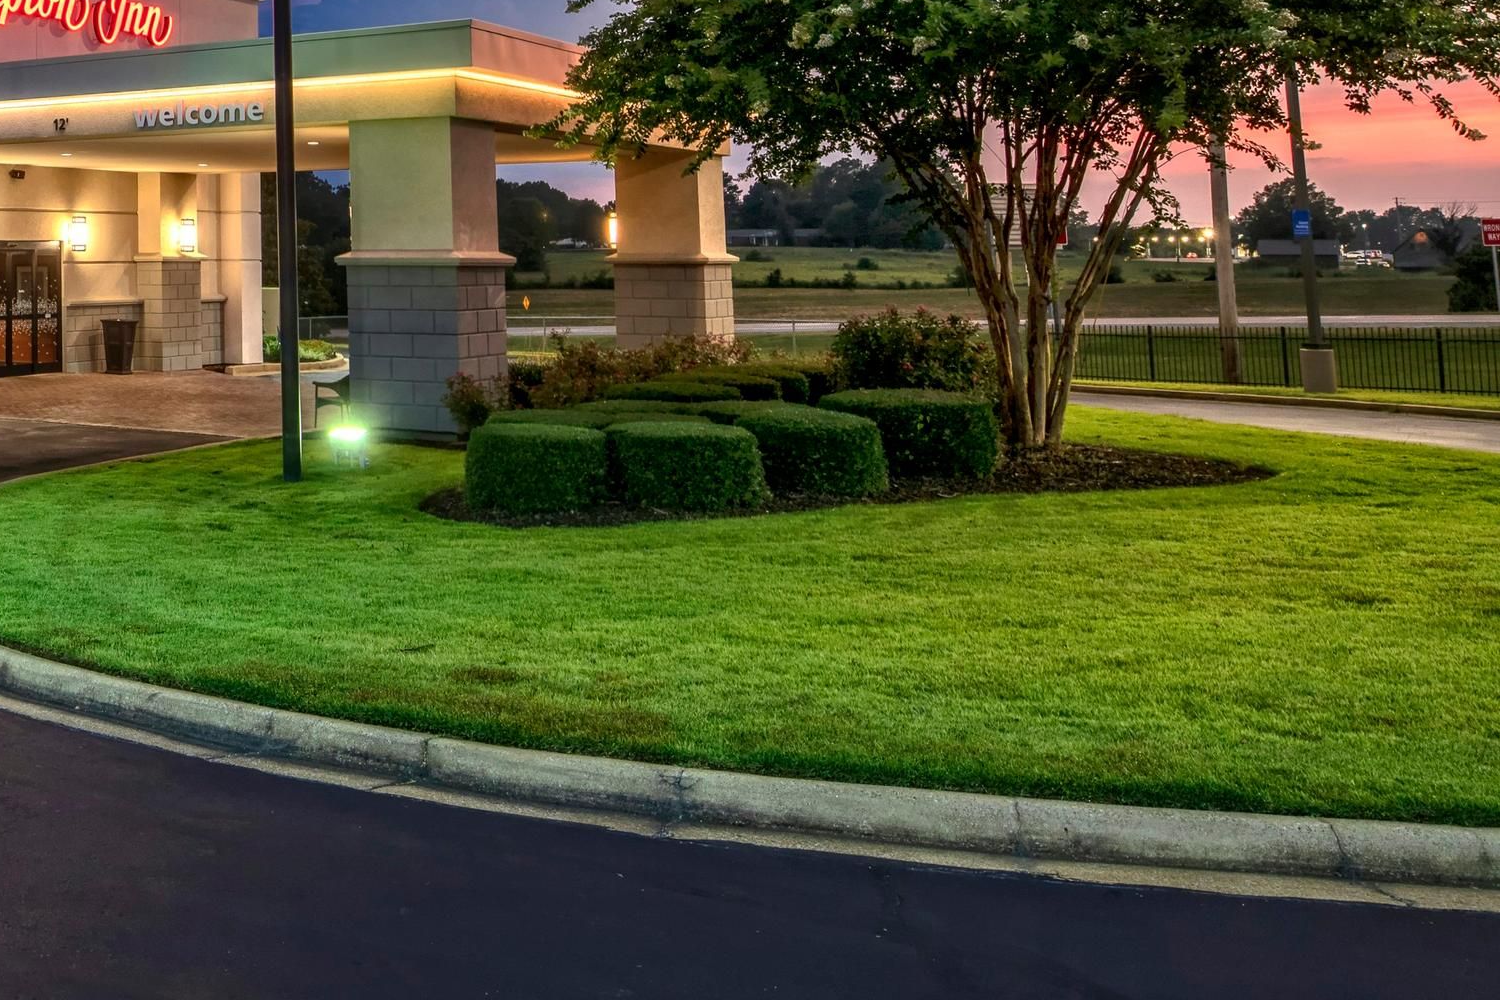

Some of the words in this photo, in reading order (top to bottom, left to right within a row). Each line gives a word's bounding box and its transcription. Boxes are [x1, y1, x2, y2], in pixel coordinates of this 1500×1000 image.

[133, 101, 265, 128] welcome
[1483, 224, 1500, 232] WRON
[1487, 233, 1500, 241] WAY
